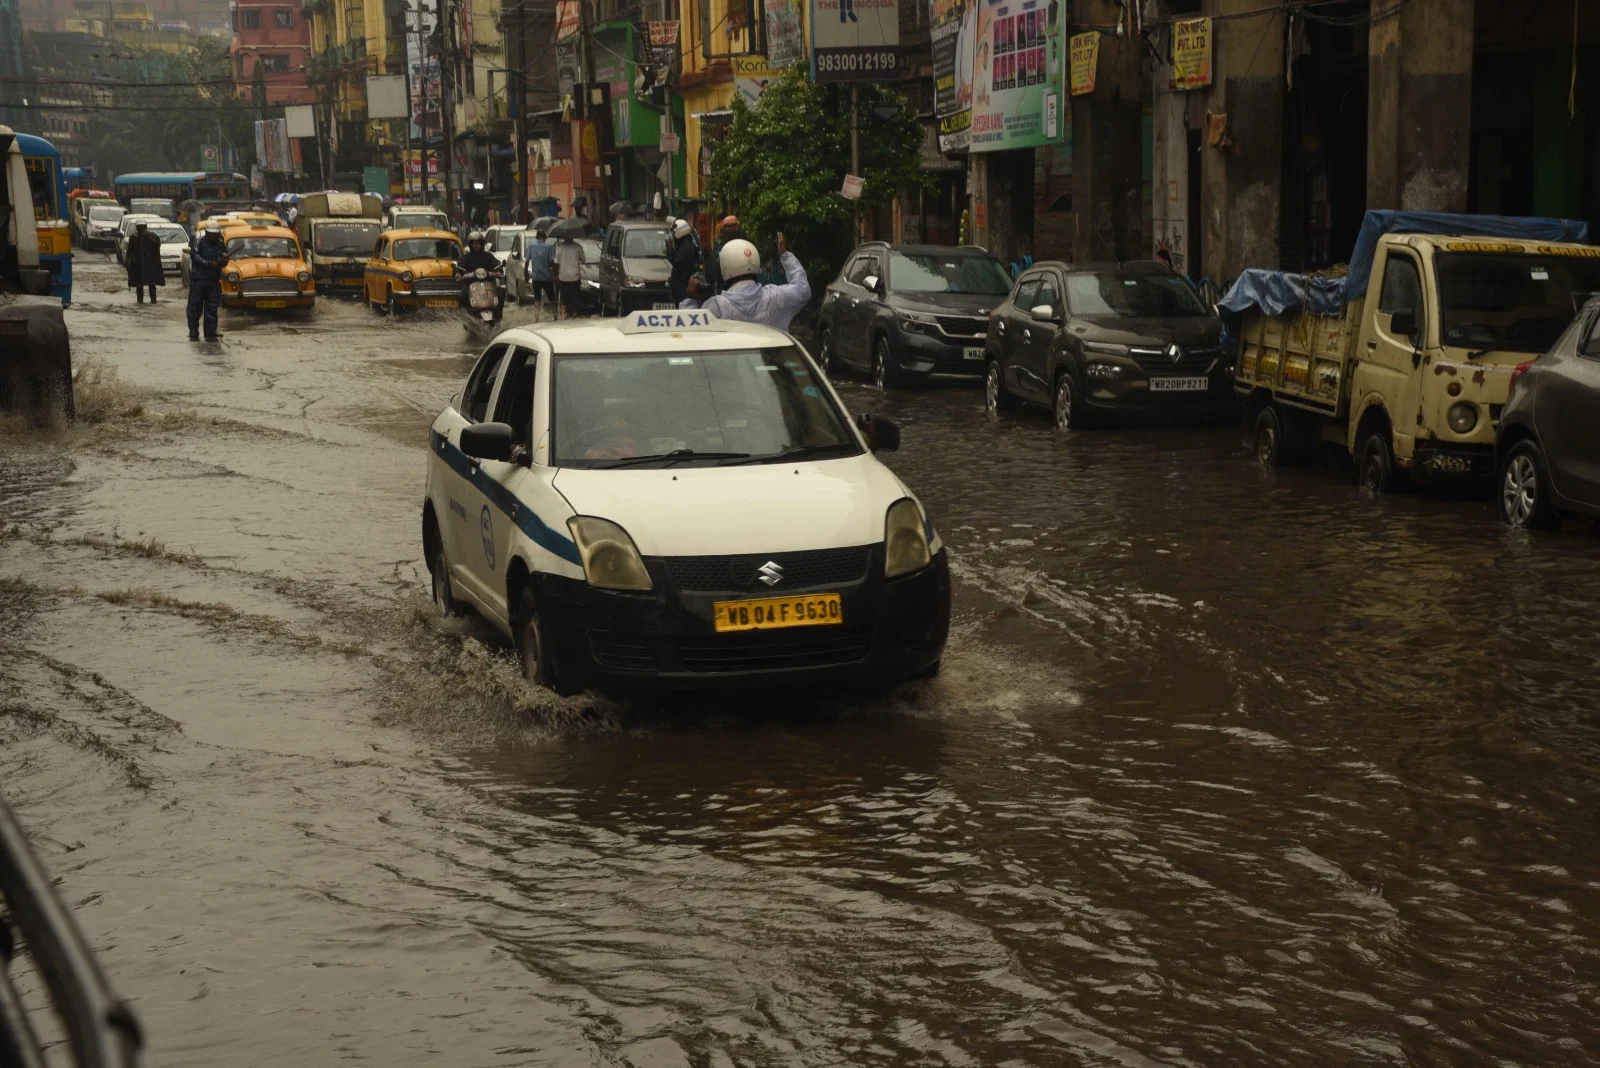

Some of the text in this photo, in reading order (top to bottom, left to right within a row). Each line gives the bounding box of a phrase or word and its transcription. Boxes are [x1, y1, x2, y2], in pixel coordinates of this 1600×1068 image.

[818, 1, 838, 9] THE
[1178, 23, 1190, 36] JRK
[1072, 37, 1083, 49] JRK
[737, 60, 769, 71] Karn
[818, 52, 895, 71] 9830012199
[1155, 379, 1207, 389] WB20BP9211
[728, 599, 839, 625] WB 04 F 9630
